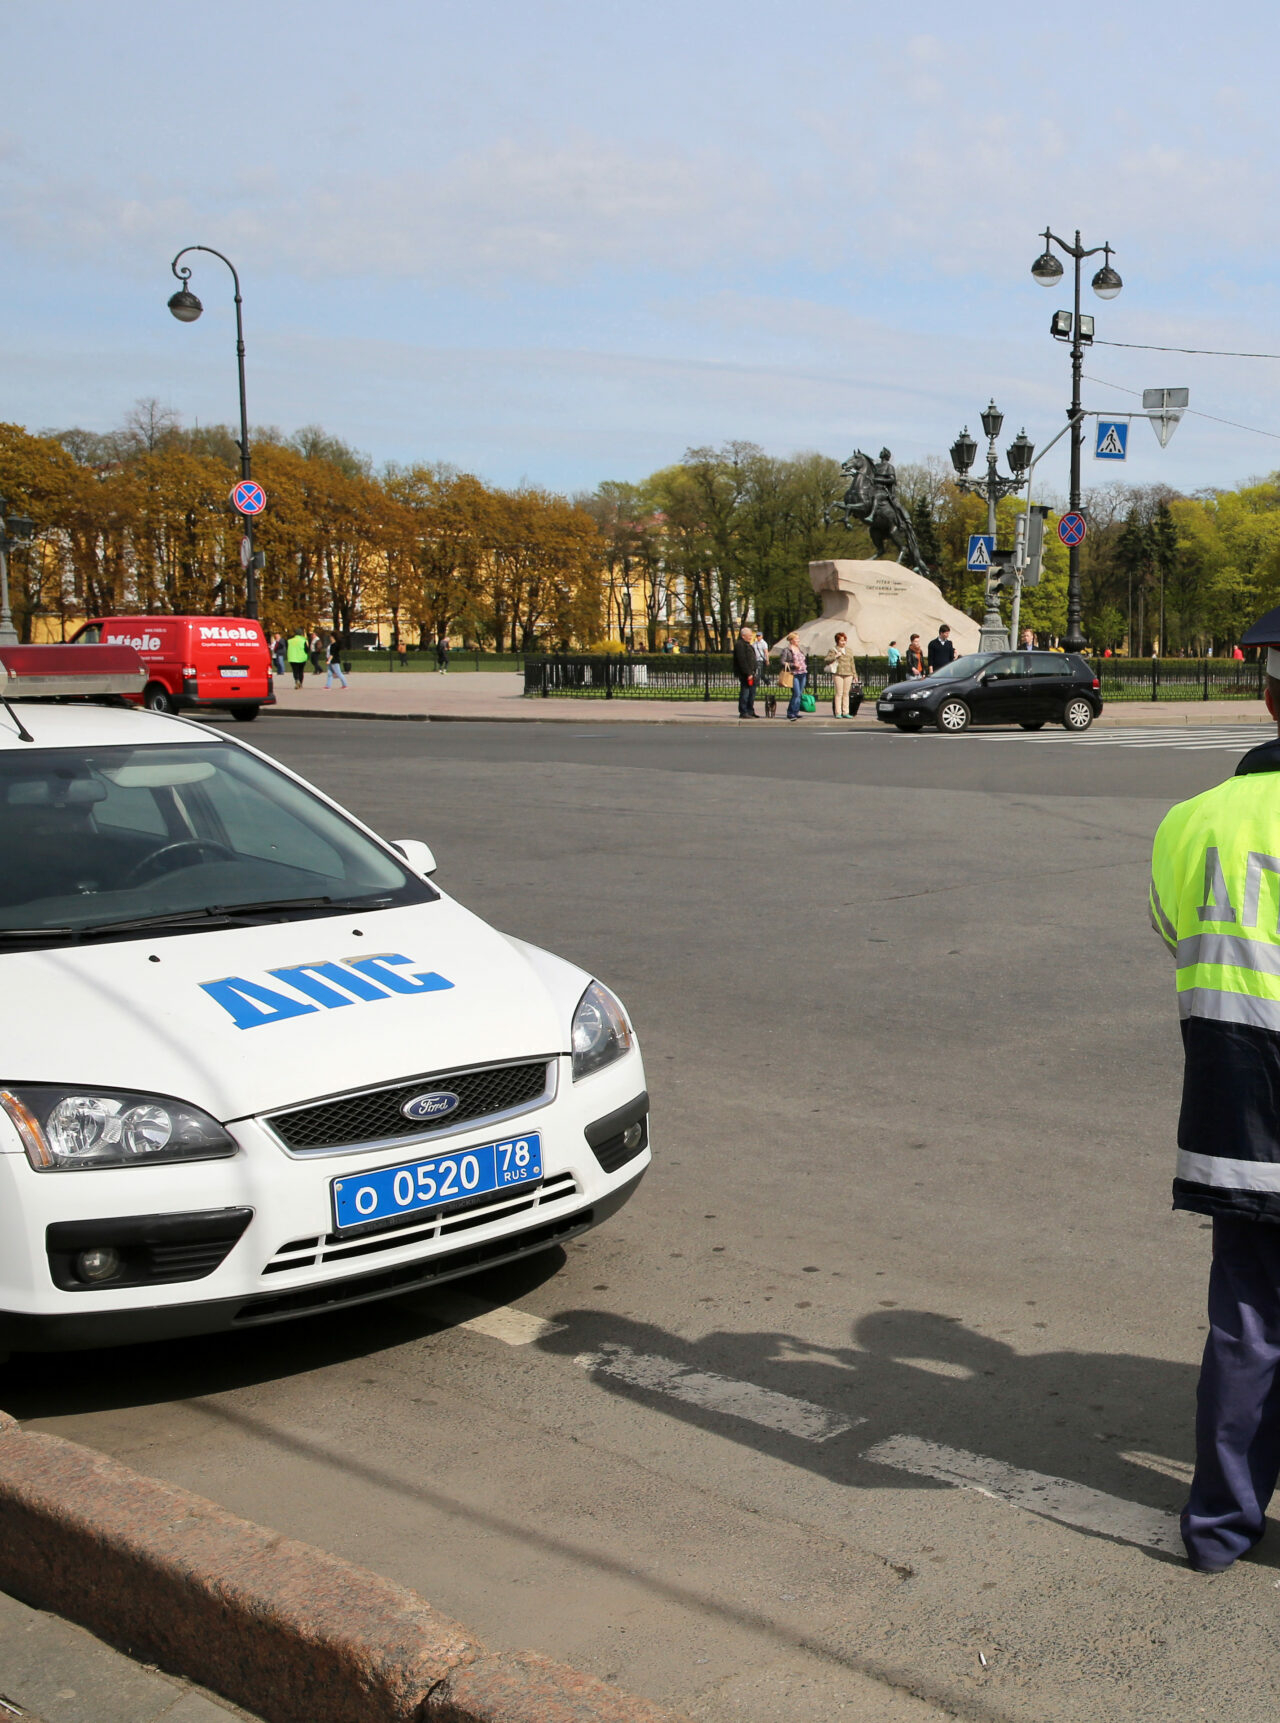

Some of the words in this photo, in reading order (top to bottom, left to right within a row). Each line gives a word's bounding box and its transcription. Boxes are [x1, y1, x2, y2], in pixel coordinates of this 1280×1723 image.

[199, 626, 258, 641] Miele
[197, 952, 456, 1031] ДПС
[418, 1097, 449, 1115] Ford
[355, 1186, 379, 1215] О
[393, 1154, 480, 1207] 0520
[498, 1140, 531, 1172] 78
[503, 1168, 528, 1183] RUS
